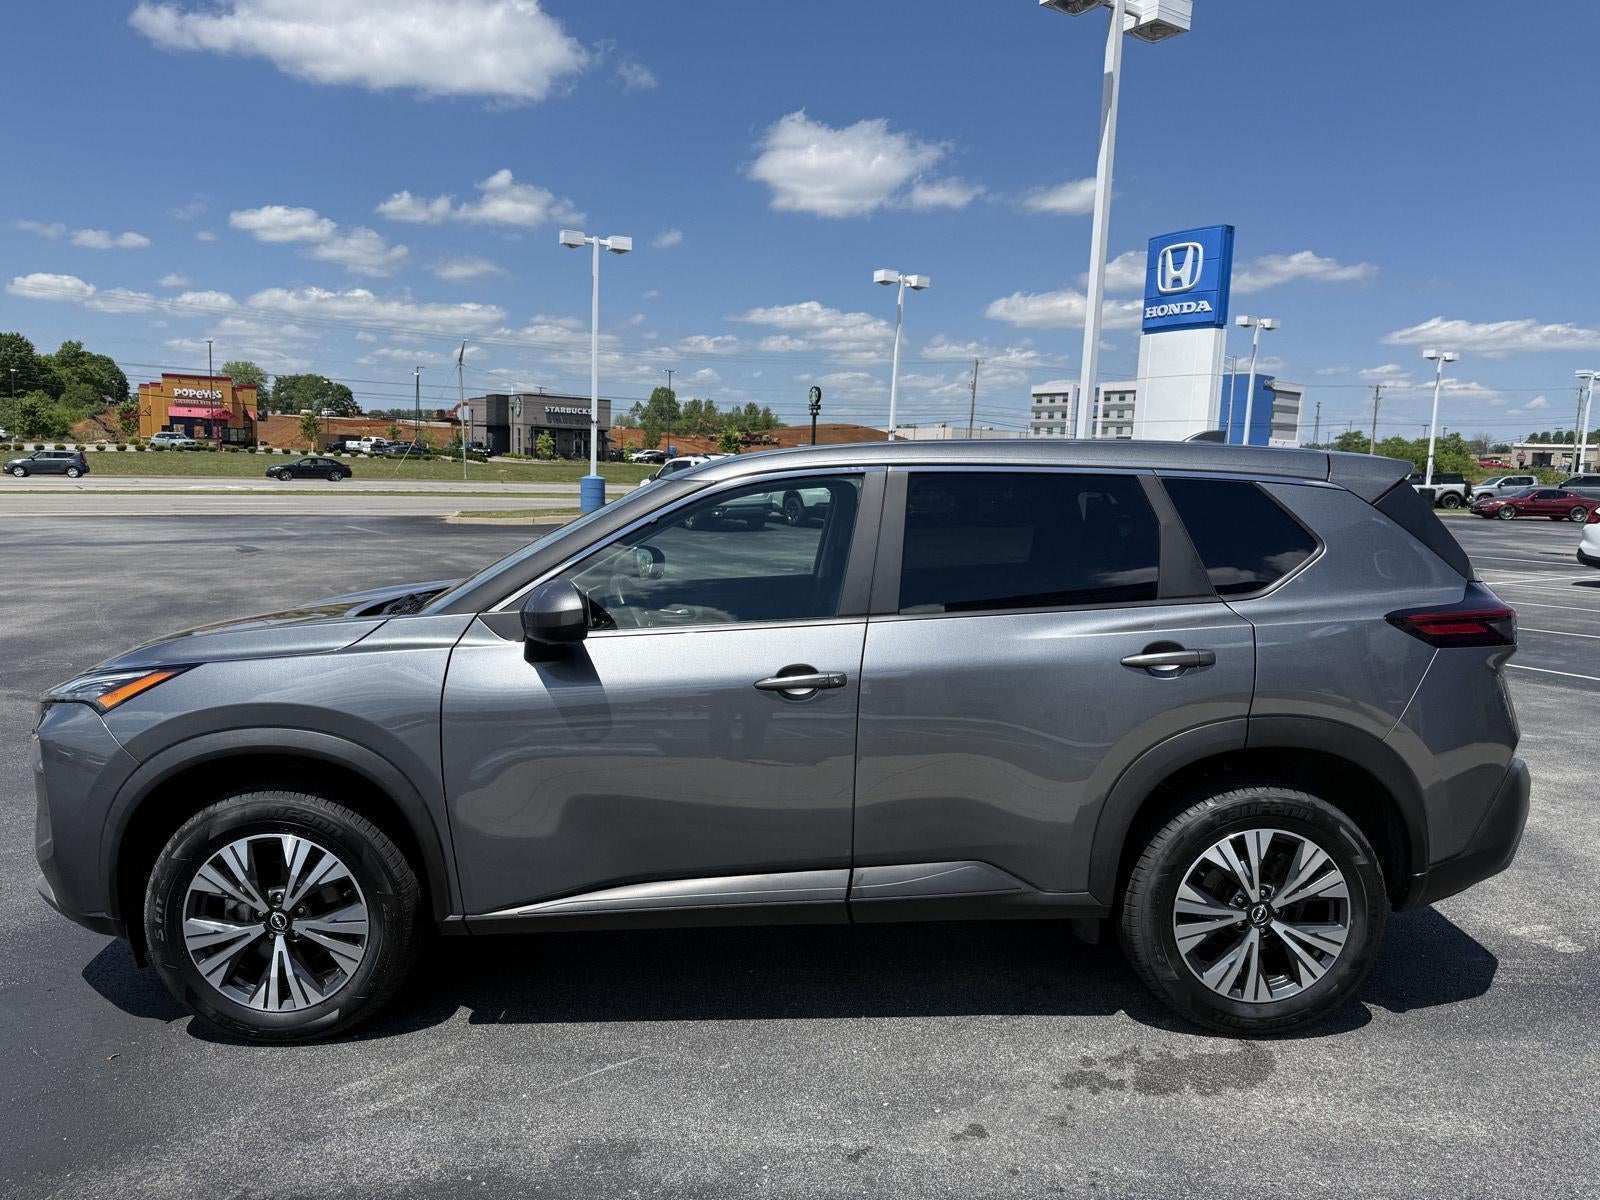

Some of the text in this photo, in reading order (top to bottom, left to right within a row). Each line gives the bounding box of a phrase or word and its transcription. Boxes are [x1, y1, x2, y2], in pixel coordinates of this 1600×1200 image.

[1144, 300, 1212, 318] HONDA
[545, 406, 592, 414] STARBUCKS
[154, 928, 165, 942] S
